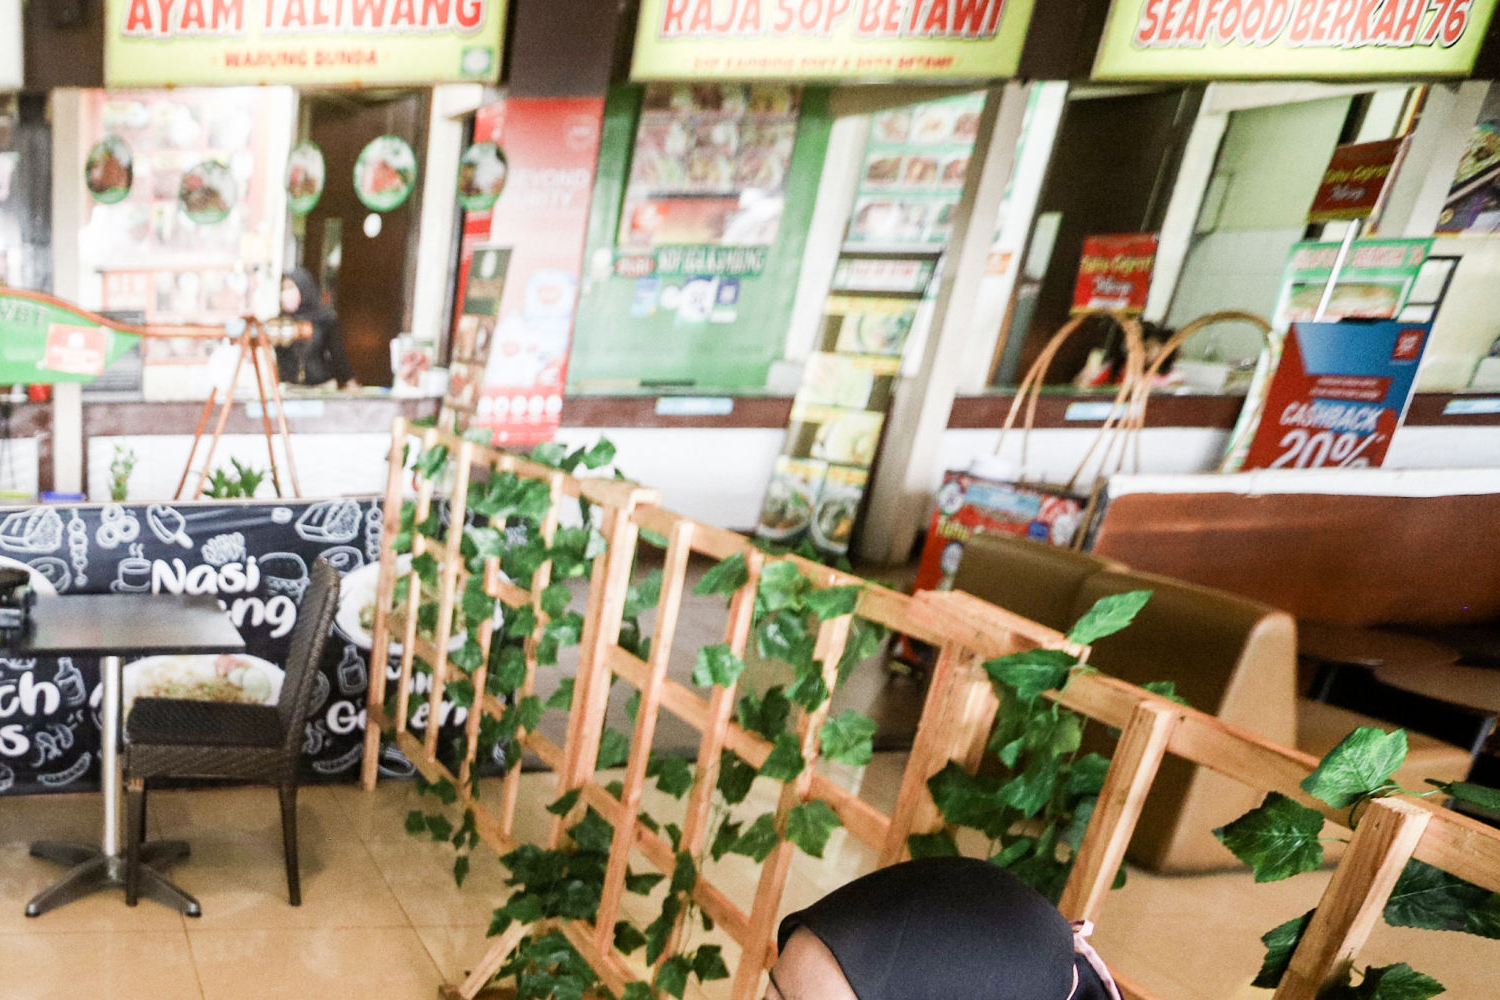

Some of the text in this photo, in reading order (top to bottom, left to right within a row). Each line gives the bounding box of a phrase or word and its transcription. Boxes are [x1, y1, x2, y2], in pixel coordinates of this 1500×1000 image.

[126, 0, 244, 34] AYAM
[661, 0, 762, 34] RAJA
[1137, 0, 1472, 44] SEAFOOD BERKAH 76
[1278, 400, 1387, 433] CASHBACK
[151, 554, 261, 596] Nasi
